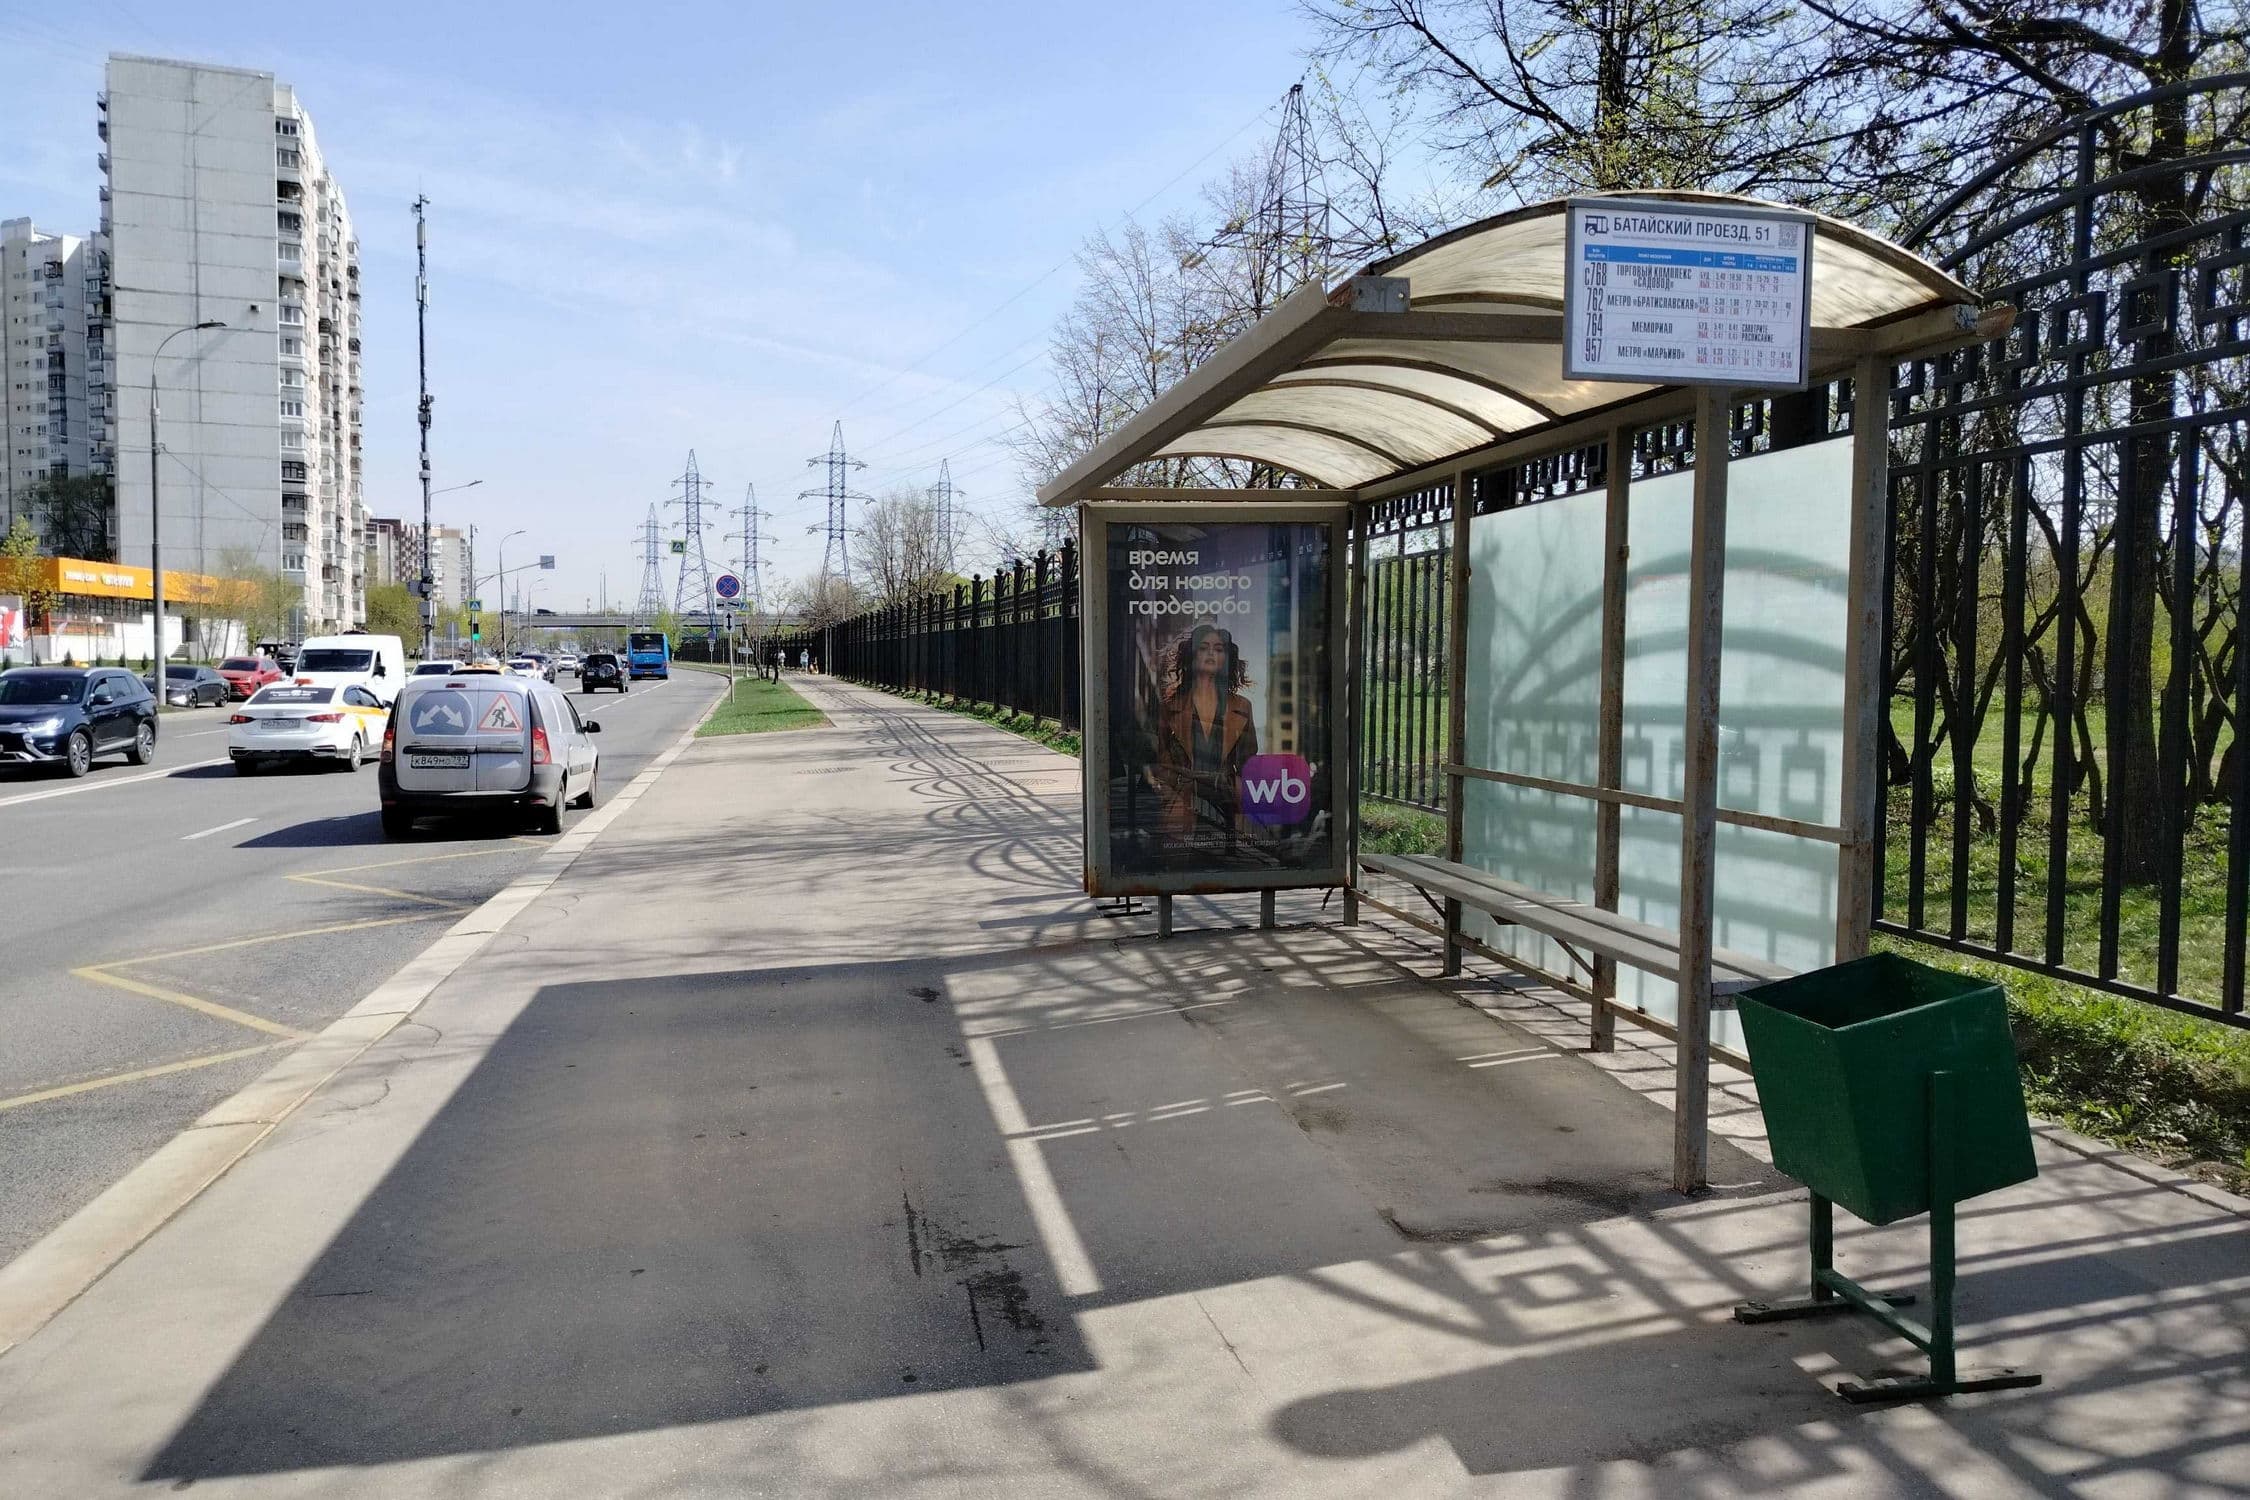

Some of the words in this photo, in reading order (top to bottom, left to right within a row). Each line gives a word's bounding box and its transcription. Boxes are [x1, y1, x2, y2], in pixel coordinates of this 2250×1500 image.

[1613, 215, 1692, 236] БАТАЙСКИЙ
[1696, 222, 1751, 241] ПРОЕЗД,
[1755, 226, 1770, 241] 51
[1616, 263, 1653, 278] ТОРГОВЫЙ
[1654, 265, 1692, 280] КОМПЛЕКС
[1586, 287, 1604, 312] 762
[1607, 294, 1631, 307] МЕТРО
[1586, 313, 1603, 337] 764
[1631, 321, 1673, 334] МЕМОРИАЛ
[1585, 338, 1602, 362] 957
[1617, 345, 1642, 358] МЕТРО
[1129, 550, 1199, 570] время
[1129, 570, 1169, 590] для
[1175, 575, 1252, 590] нового
[1129, 594, 1251, 619] гардероба
[1245, 768, 1307, 804] wb
